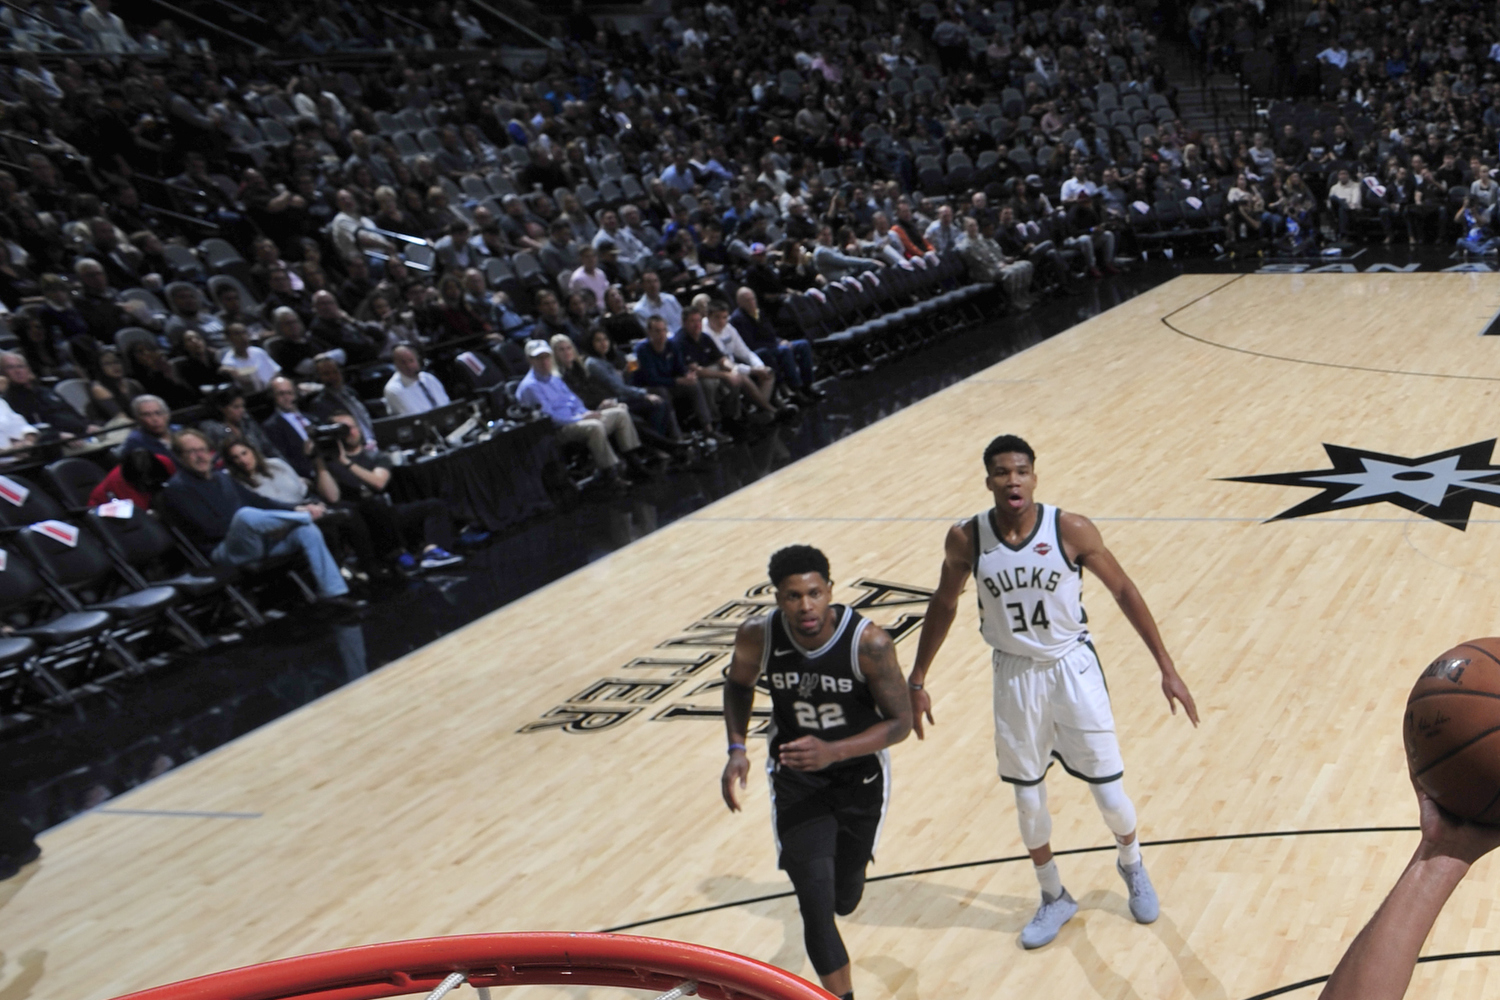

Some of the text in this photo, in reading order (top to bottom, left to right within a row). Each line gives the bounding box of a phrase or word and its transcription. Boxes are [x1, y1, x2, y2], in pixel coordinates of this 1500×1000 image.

[1255, 262, 1422, 274] SAN
[983, 566, 1062, 599] BUCKS
[1006, 600, 1050, 633] 34
[771, 671, 854, 698] SPURS
[792, 701, 848, 730] 22
